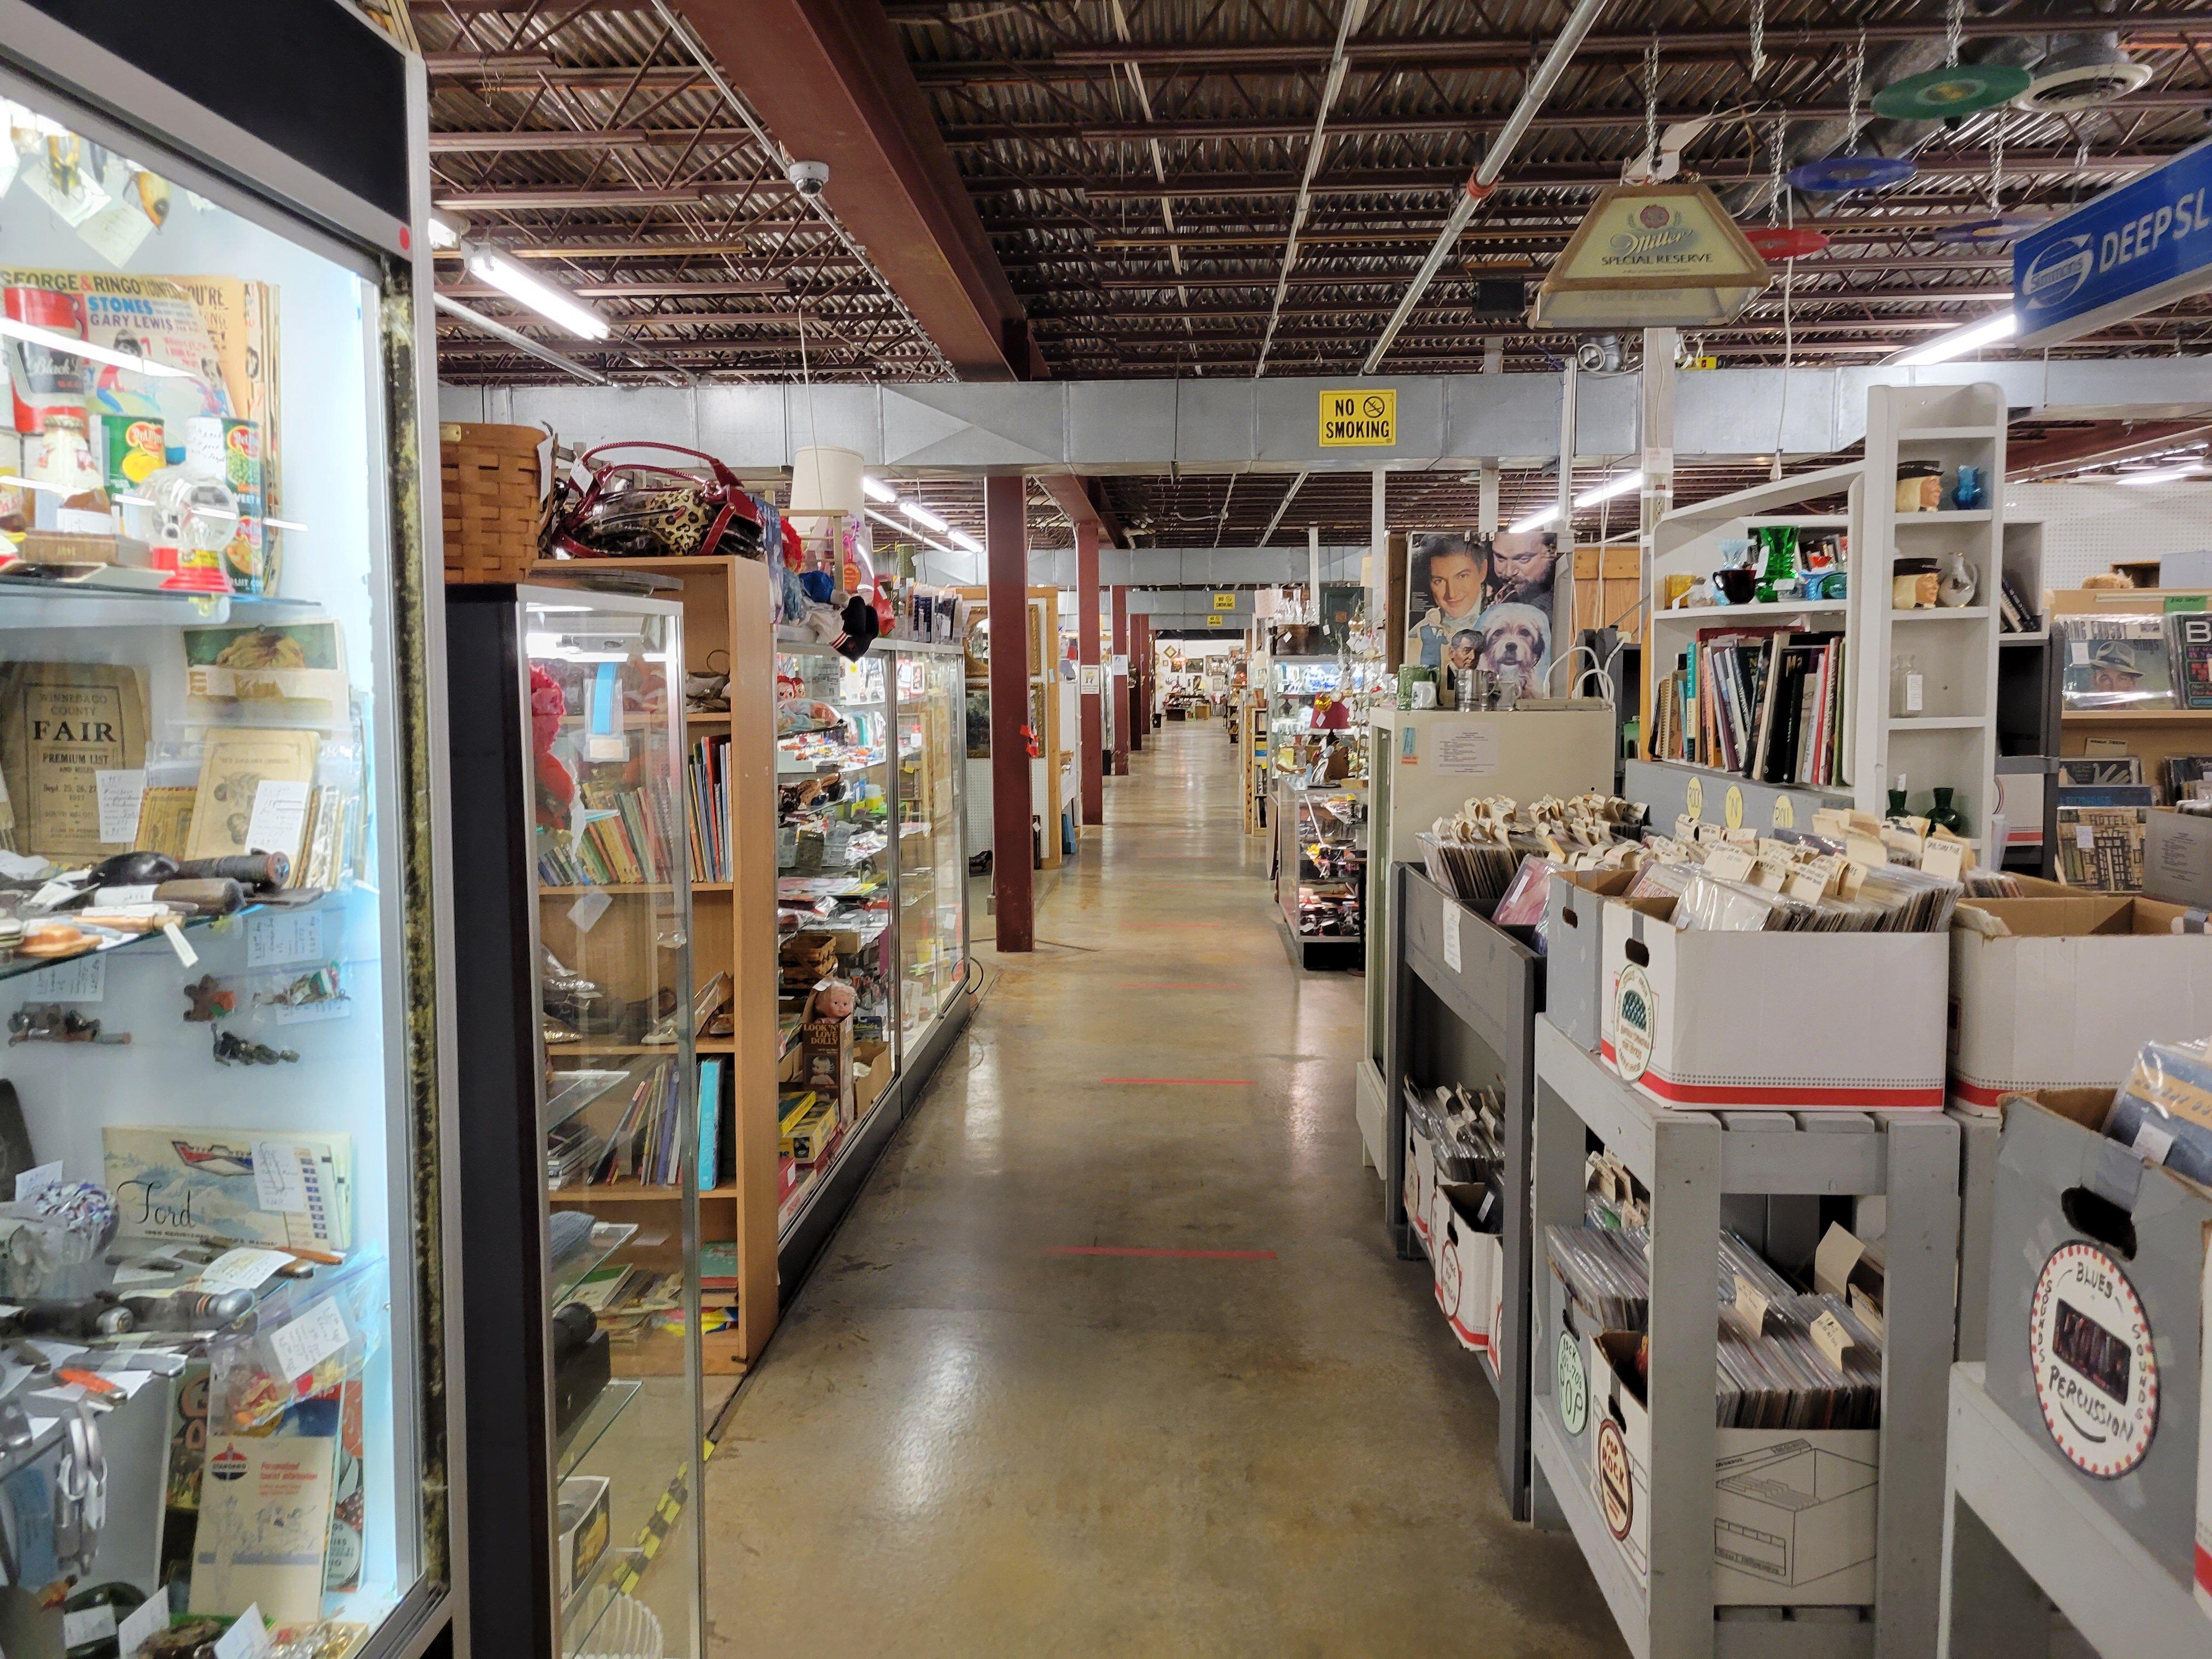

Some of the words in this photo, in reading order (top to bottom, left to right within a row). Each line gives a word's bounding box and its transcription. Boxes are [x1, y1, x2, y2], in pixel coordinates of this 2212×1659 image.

[2099, 187, 2209, 273] DEEPSL
[1610, 229, 1694, 258] Miller
[1601, 255, 1654, 266] SPECIAL
[1656, 253, 1713, 264] RESERVE
[80, 274, 93, 291] &
[94, 275, 141, 295] RINGO
[88, 295, 153, 315] STONES
[90, 313, 129, 328] GARY
[134, 314, 173, 330] LEWIS
[1334, 398, 1355, 416] NO
[1325, 420, 1390, 439] SMOKING
[50, 706, 97, 716] COUNTY
[32, 720, 118, 742] FAIR
[42, 752, 86, 764] PREMIUM
[90, 754, 109, 765] LIST
[815, 1030, 838, 1039] LOVE
[116, 1179, 197, 1228] Ford
[2075, 1261, 2113, 1299] BLUES
[2038, 1279, 2053, 1363] SOUNDS
[2131, 1323, 2149, 1421] SOUNDS
[2048, 1365, 2135, 1443] PERCUSSION
[1606, 1435, 1618, 1457] POP
[1602, 1446, 1625, 1491] ROCK
